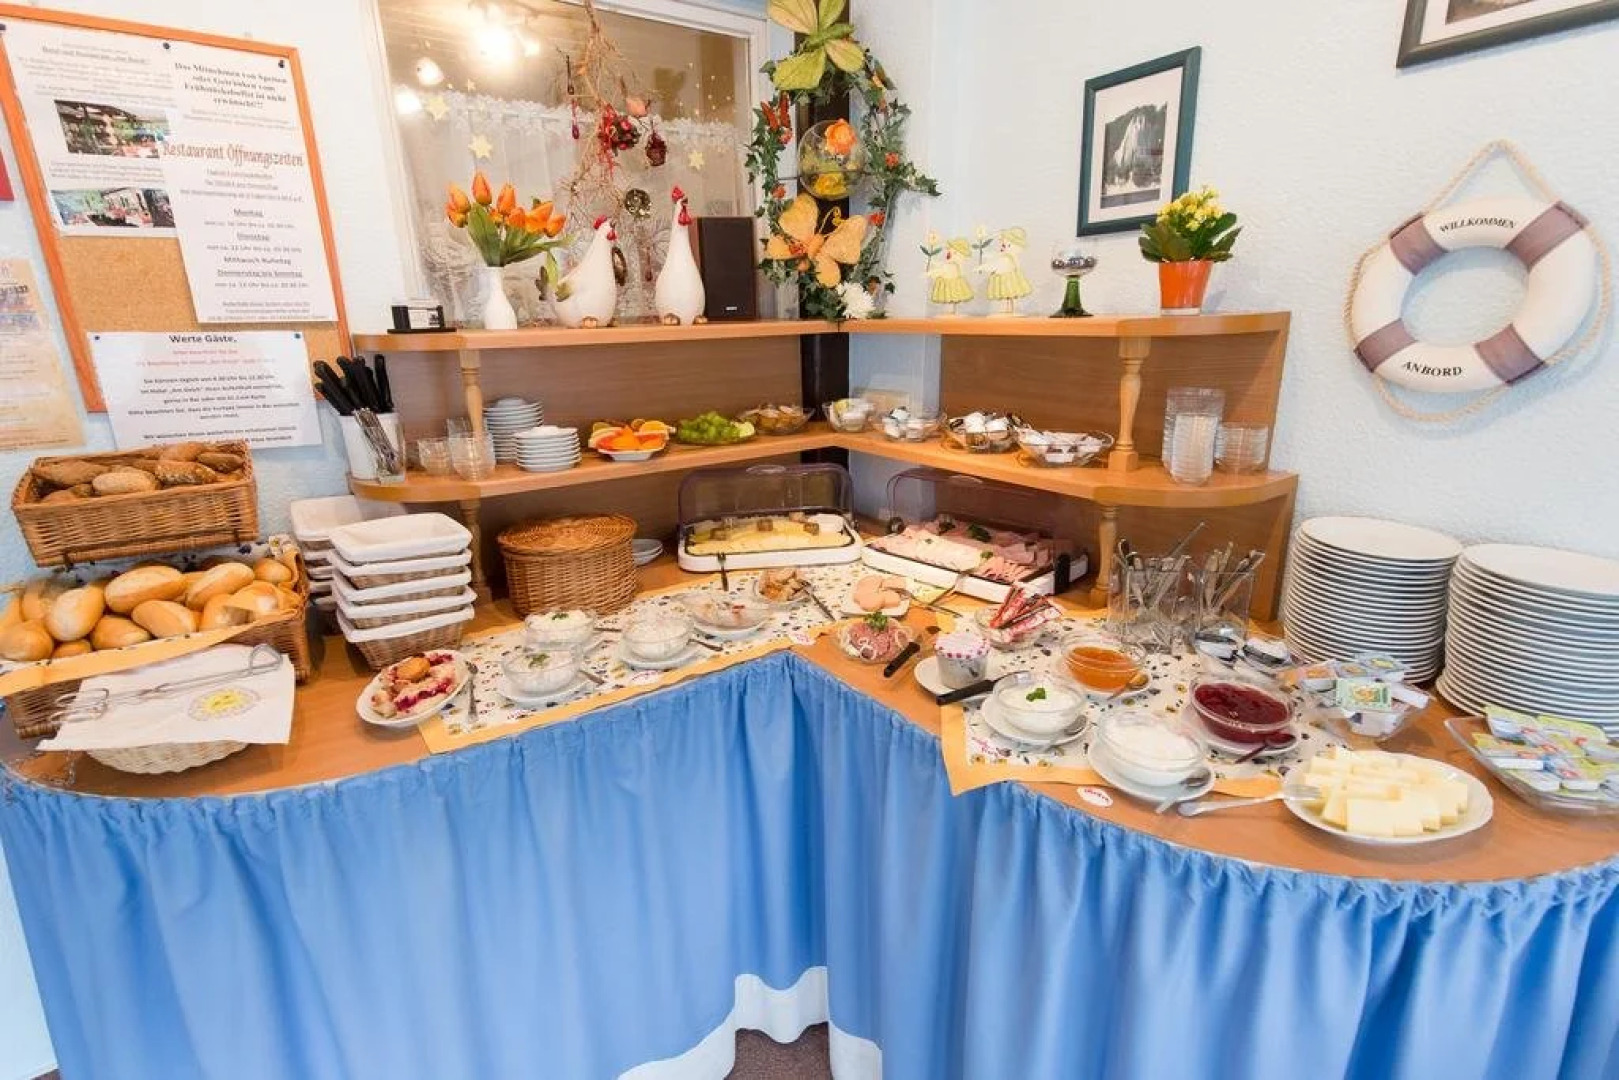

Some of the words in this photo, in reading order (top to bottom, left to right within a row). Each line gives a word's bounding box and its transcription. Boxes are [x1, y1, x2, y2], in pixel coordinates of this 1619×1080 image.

[175, 62, 191, 71] Das
[193, 64, 240, 77] Mitnehmen
[259, 75, 287, 84] Speisen
[162, 142, 223, 160] Restaurant
[227, 143, 304, 168] Öffnungszeiten
[234, 208, 264, 218] Montag
[1439, 217, 1517, 232] WILLKOMMEN
[237, 232, 270, 241] Dienstag
[224, 256, 260, 265] Mittwoch
[217, 269, 260, 277] Donnerstag
[169, 335, 202, 343] Werte
[205, 334, 238, 343] Gäste,
[1401, 361, 1463, 376] ANBORD
